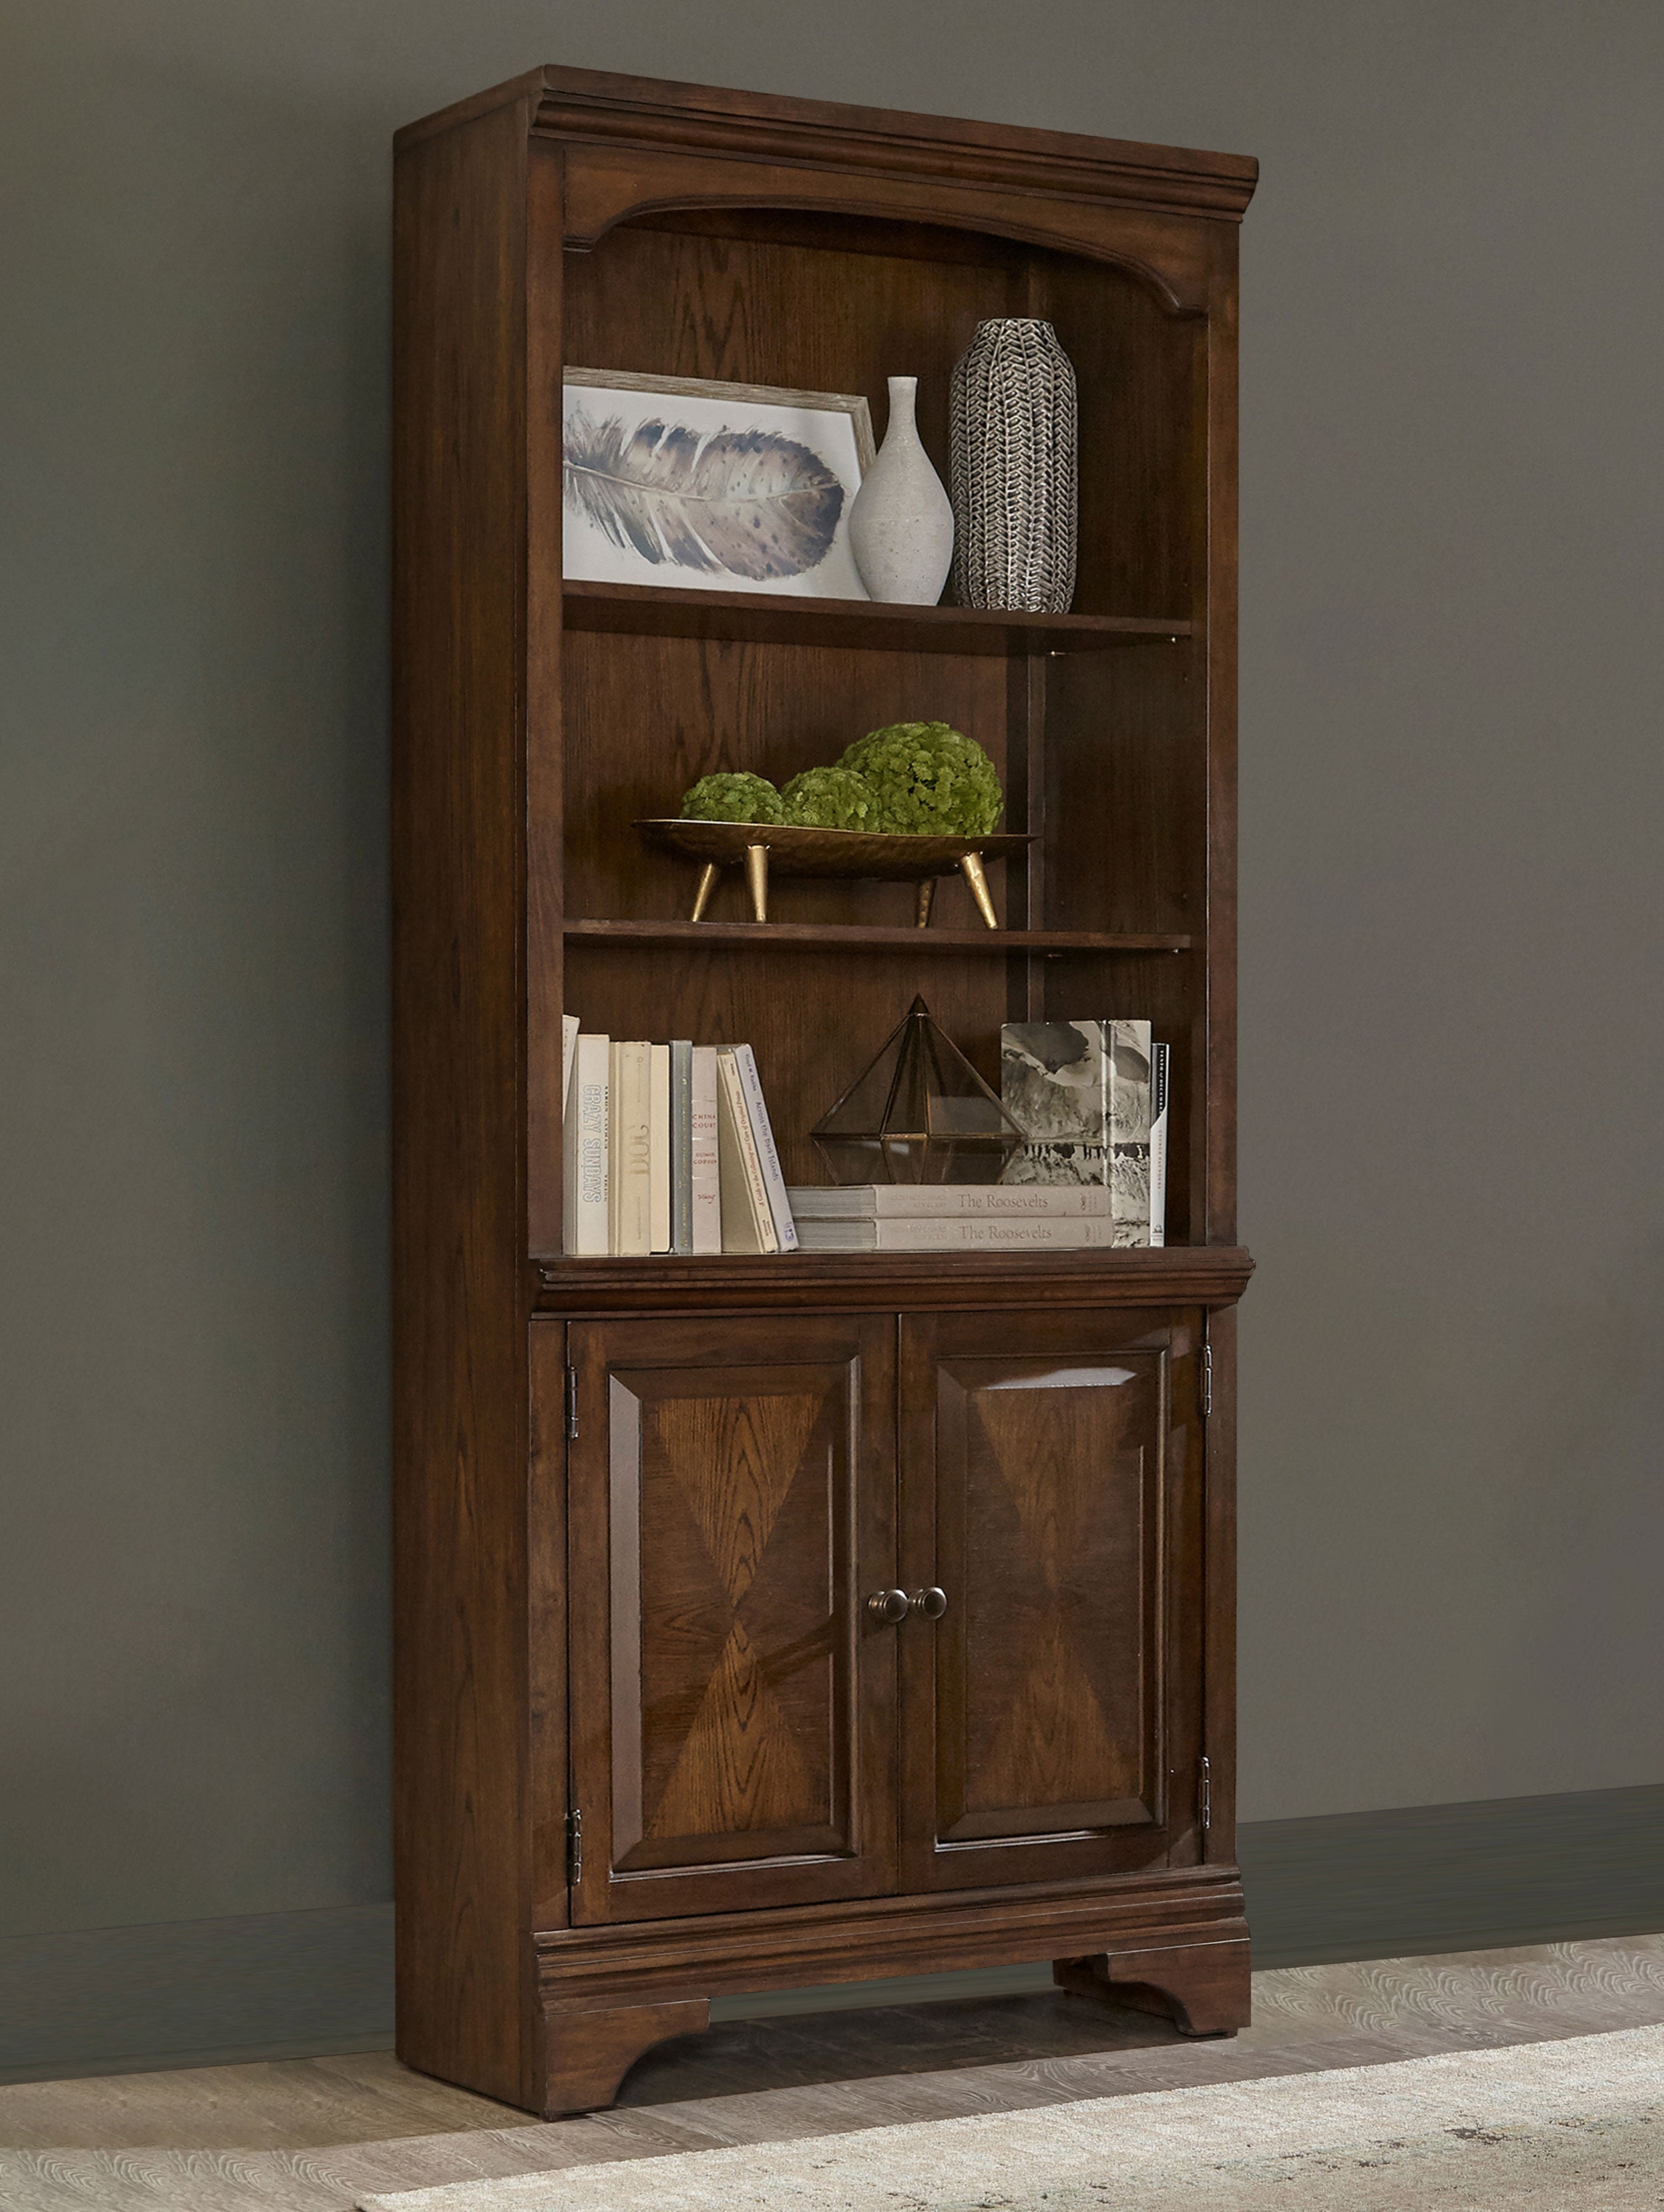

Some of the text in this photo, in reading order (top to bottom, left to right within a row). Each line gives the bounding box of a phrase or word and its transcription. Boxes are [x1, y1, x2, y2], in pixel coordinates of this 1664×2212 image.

[582, 1084, 602, 1202] CRAZY SUNDAYS
[755, 1101, 779, 1181] Across the Dark Islands
[958, 1194, 982, 1208] The
[986, 1193, 1048, 1208] Roosevelts
[959, 1225, 985, 1240] The
[988, 1224, 1052, 1240] Roosevelts
